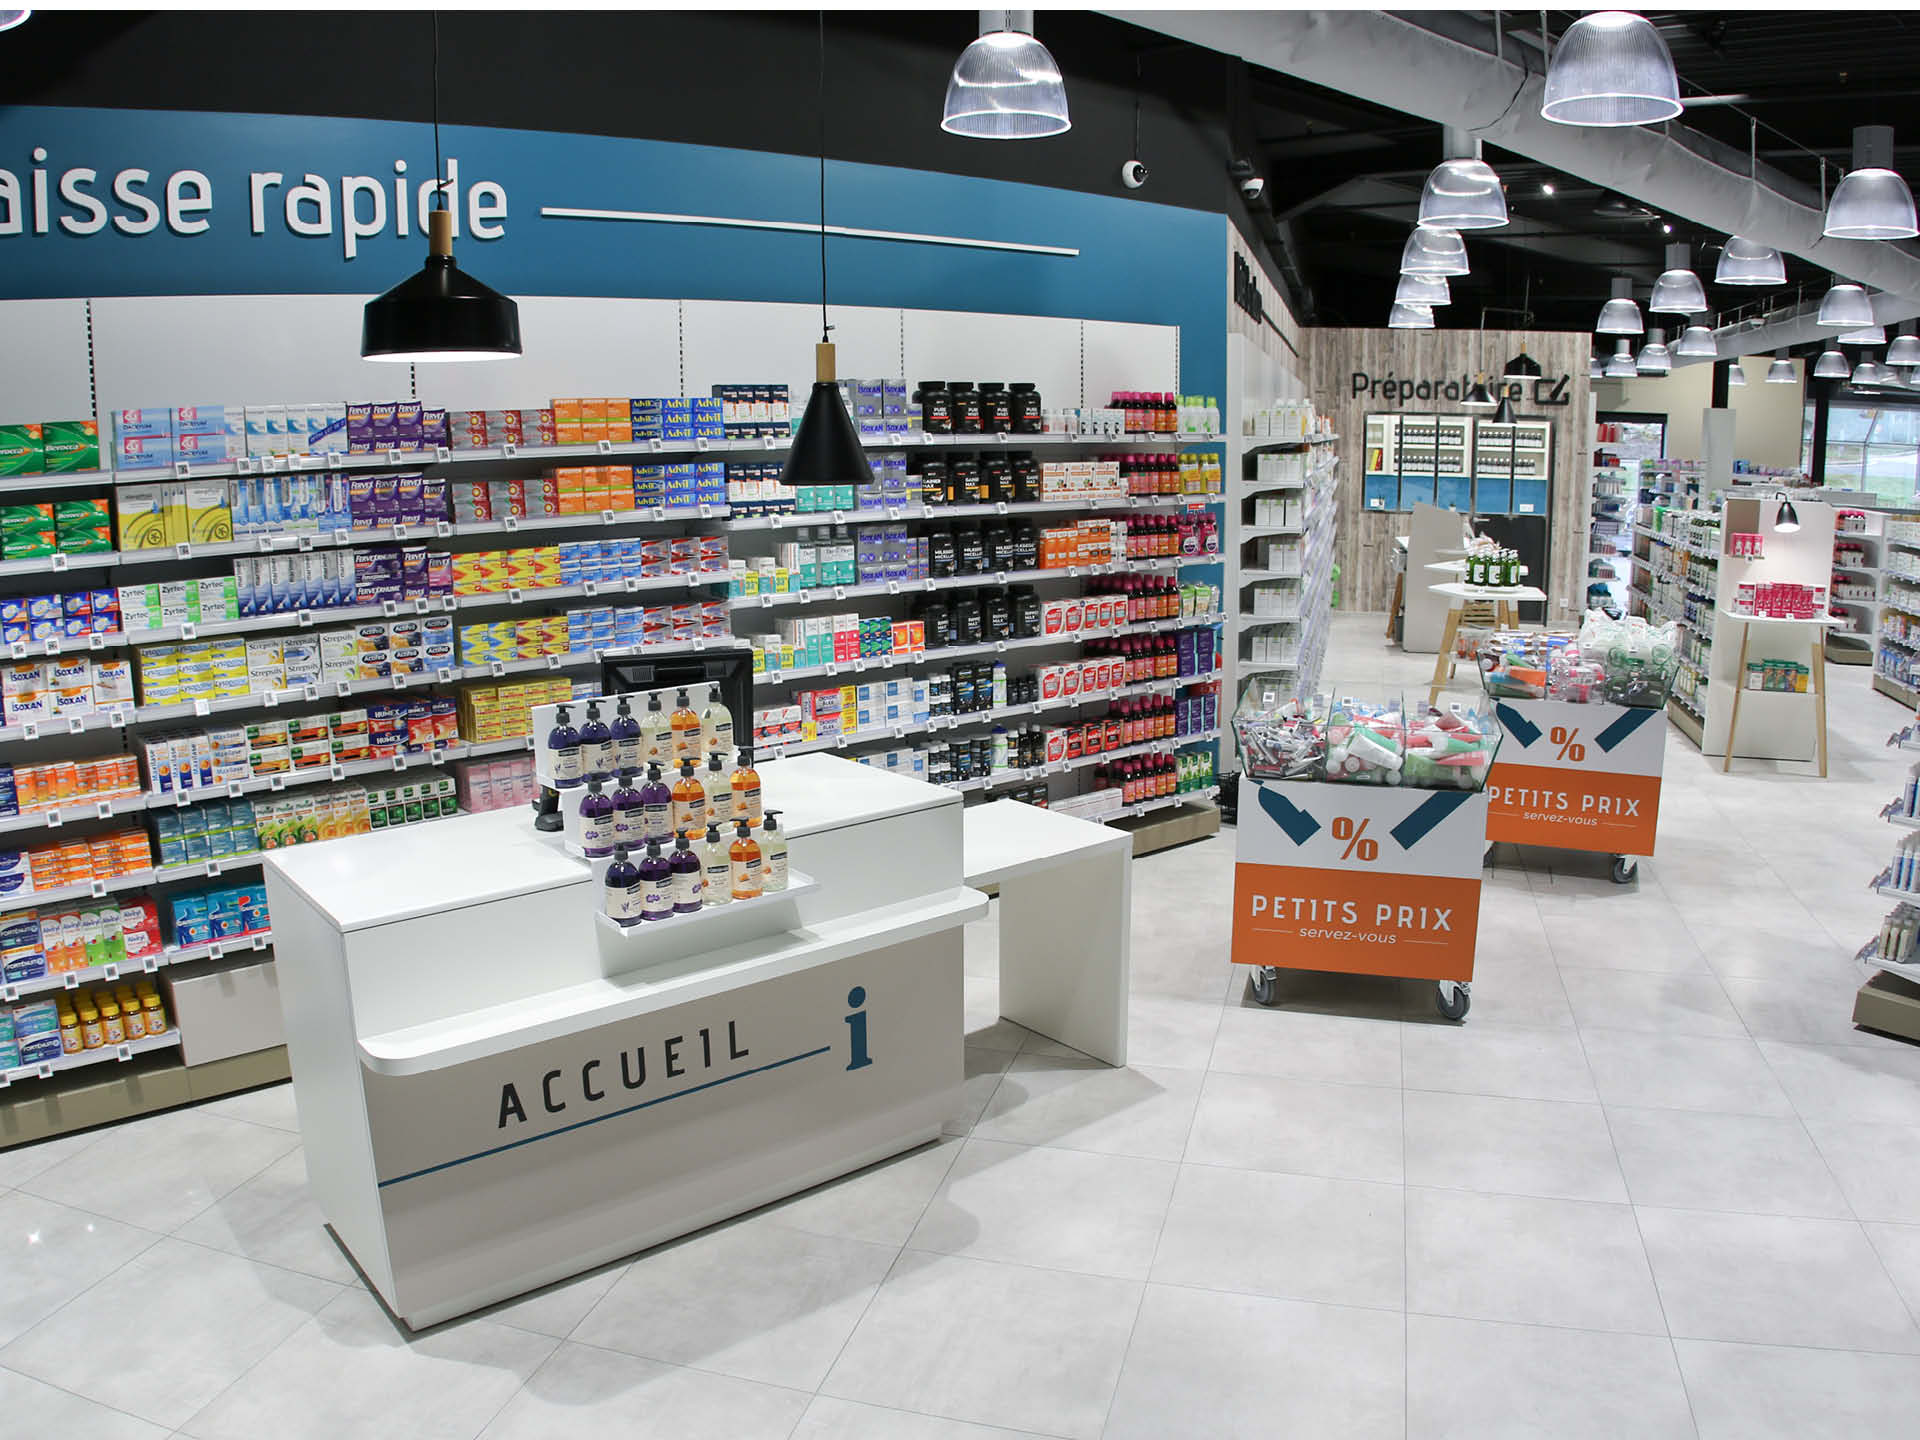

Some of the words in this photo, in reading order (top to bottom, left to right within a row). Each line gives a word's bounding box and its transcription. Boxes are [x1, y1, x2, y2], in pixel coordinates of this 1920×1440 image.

[249, 157, 508, 260] rapide
[1351, 371, 1523, 407] Préparatire
[665, 399, 690, 409] Advil
[696, 398, 721, 408] Advil
[666, 413, 690, 423] Advil
[696, 412, 721, 423] Advil
[667, 428, 691, 438] Advil
[696, 427, 721, 437] Advil
[666, 464, 689, 474] Advil
[696, 463, 719, 473] Advil
[667, 479, 689, 489] Advil
[696, 477, 719, 488] Advil
[668, 494, 690, 504] Advil
[696, 493, 719, 503] Advil
[161, 585, 186, 594] Zyrtec
[200, 580, 224, 589] Zyrtec
[121, 589, 145, 598] Zyrtec
[163, 606, 188, 616] Zyrtec
[201, 602, 225, 612] Zyrtec
[124, 611, 149, 620] Zyrtec
[1550, 726, 1585, 762] %
[1487, 785, 1569, 811] PETITS
[1581, 794, 1641, 817] PRIX
[1523, 811, 1598, 827] servez-vous
[1331, 816, 1379, 862] %
[1251, 894, 1359, 925] PETITS
[1375, 903, 1454, 932] PRIX
[1299, 925, 1397, 945] servez-vous
[496, 1020, 750, 1129] ACCUEIL
